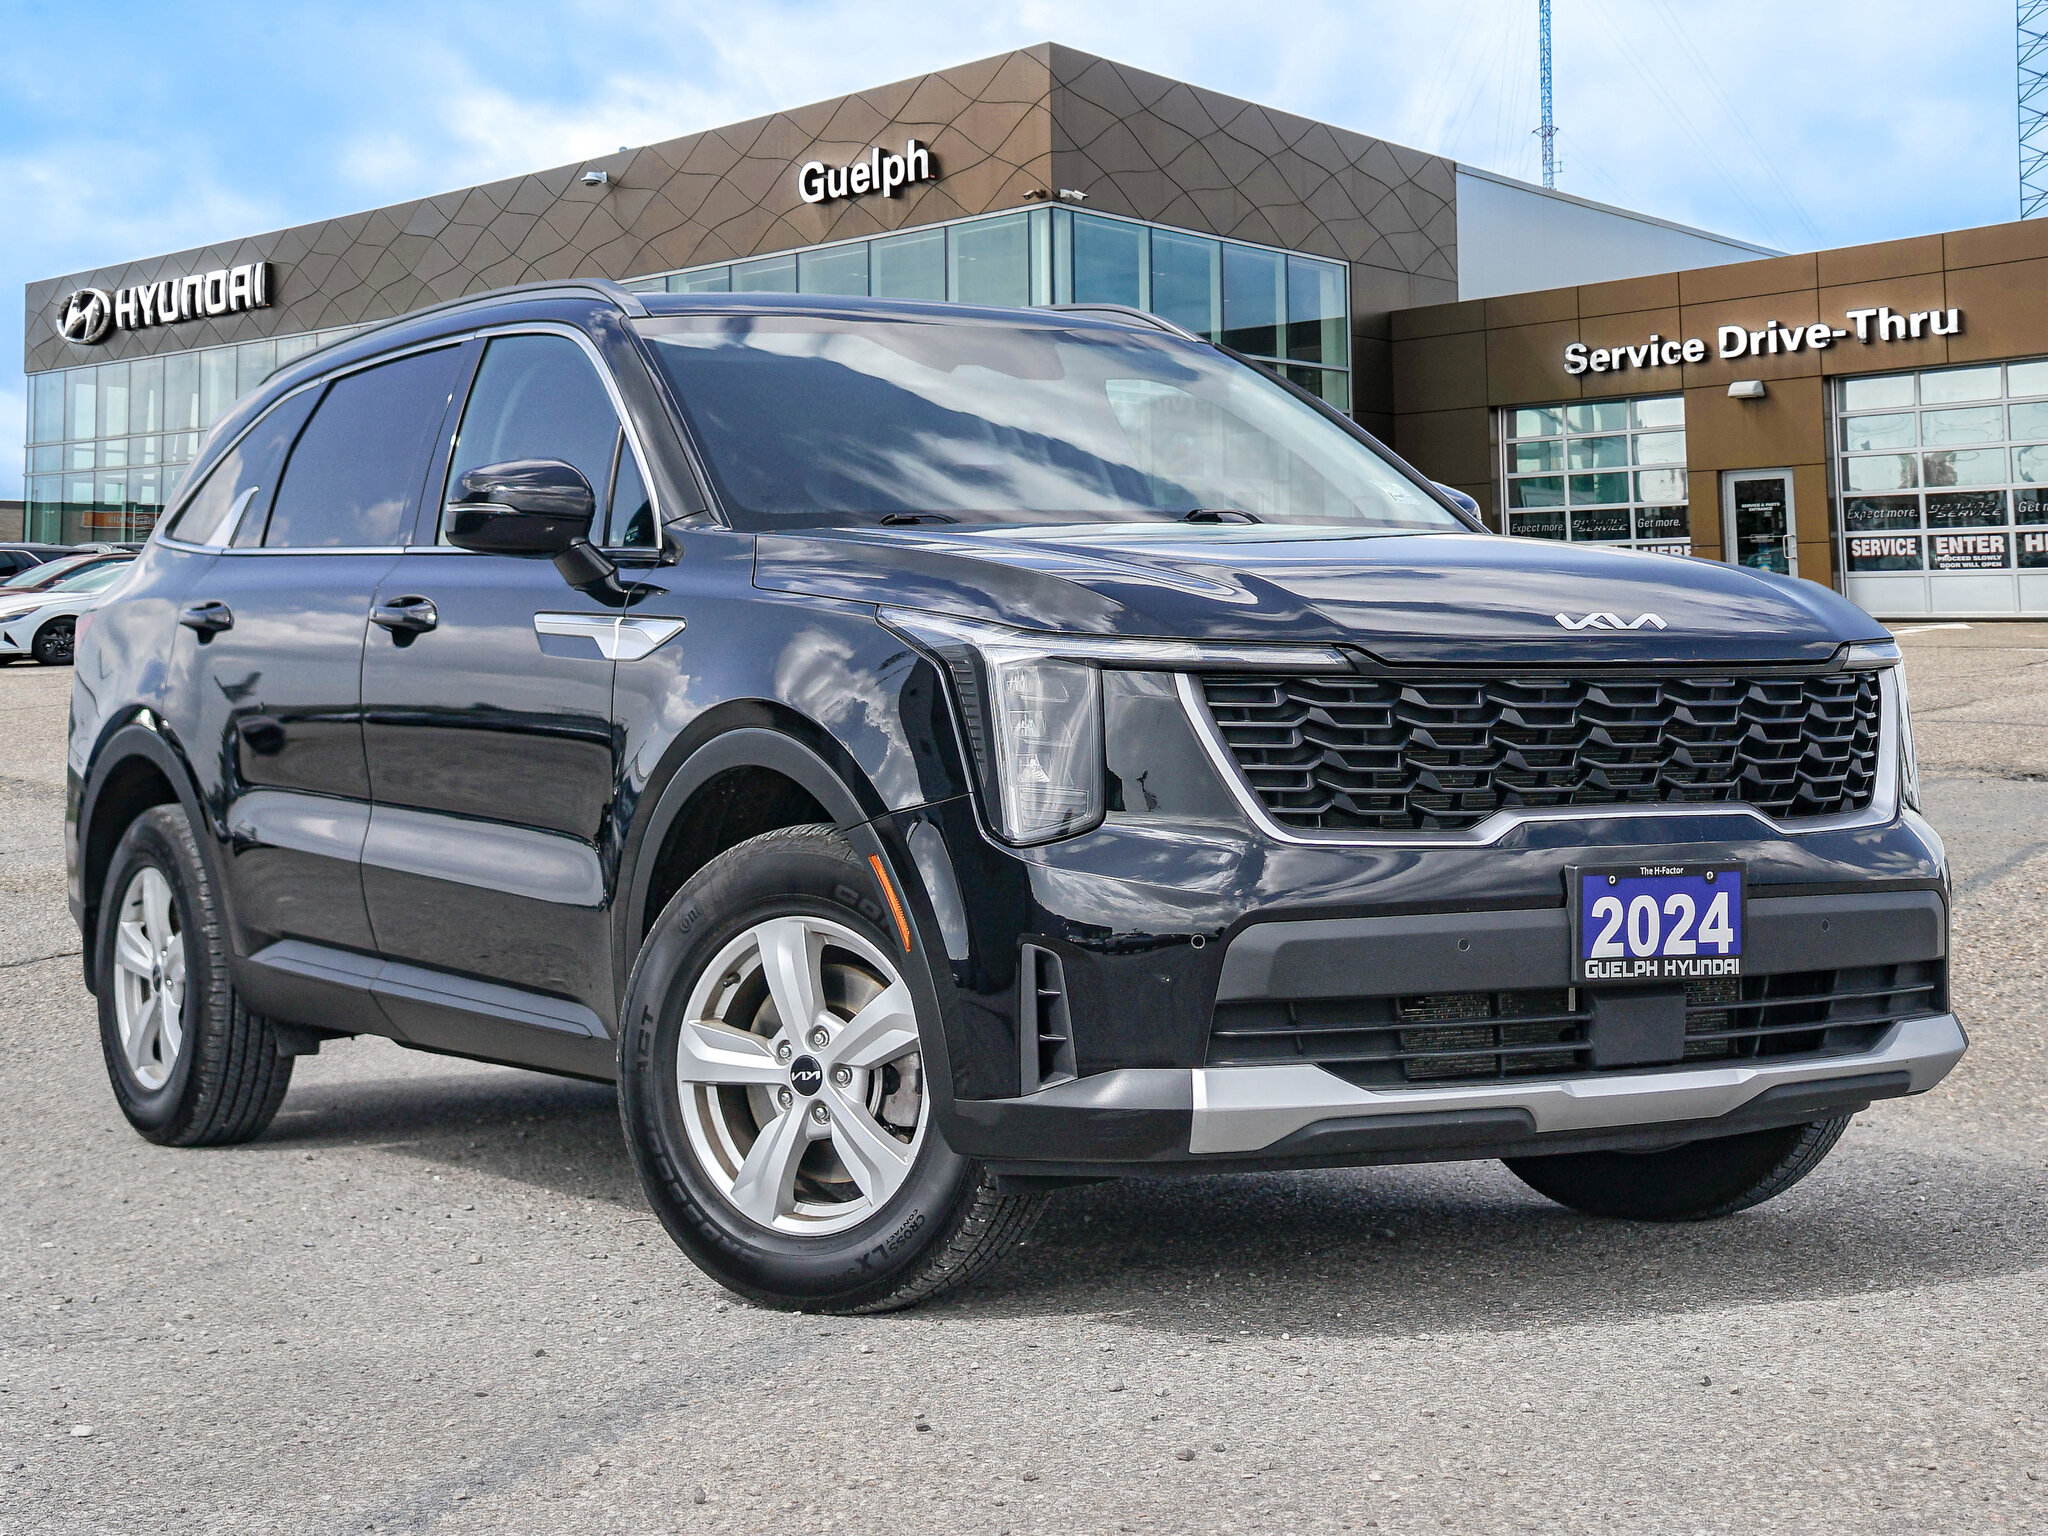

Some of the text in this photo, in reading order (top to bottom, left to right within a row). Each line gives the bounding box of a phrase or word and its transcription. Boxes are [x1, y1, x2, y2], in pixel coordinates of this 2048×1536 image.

[798, 138, 930, 203] Guelph
[115, 262, 270, 329] HYUNDAI
[1563, 306, 1962, 375] Service Drive-Thru
[1847, 508, 1918, 521] Expect more.
[1936, 508, 2003, 518] SERVICE
[2018, 501, 2040, 513] Get
[1511, 523, 1565, 535] Expect more.
[1637, 517, 1681, 528] Get more.
[1851, 538, 1917, 557] SERVICE
[1935, 535, 2005, 554] ENTER
[1640, 866, 1684, 876] The H-Factor
[1590, 891, 1734, 958] 2024
[1584, 958, 1740, 979] GUELPH HYUNDAI
[886, 1208, 918, 1245] CONTACT
[854, 1214, 925, 1270] CROSS LX
